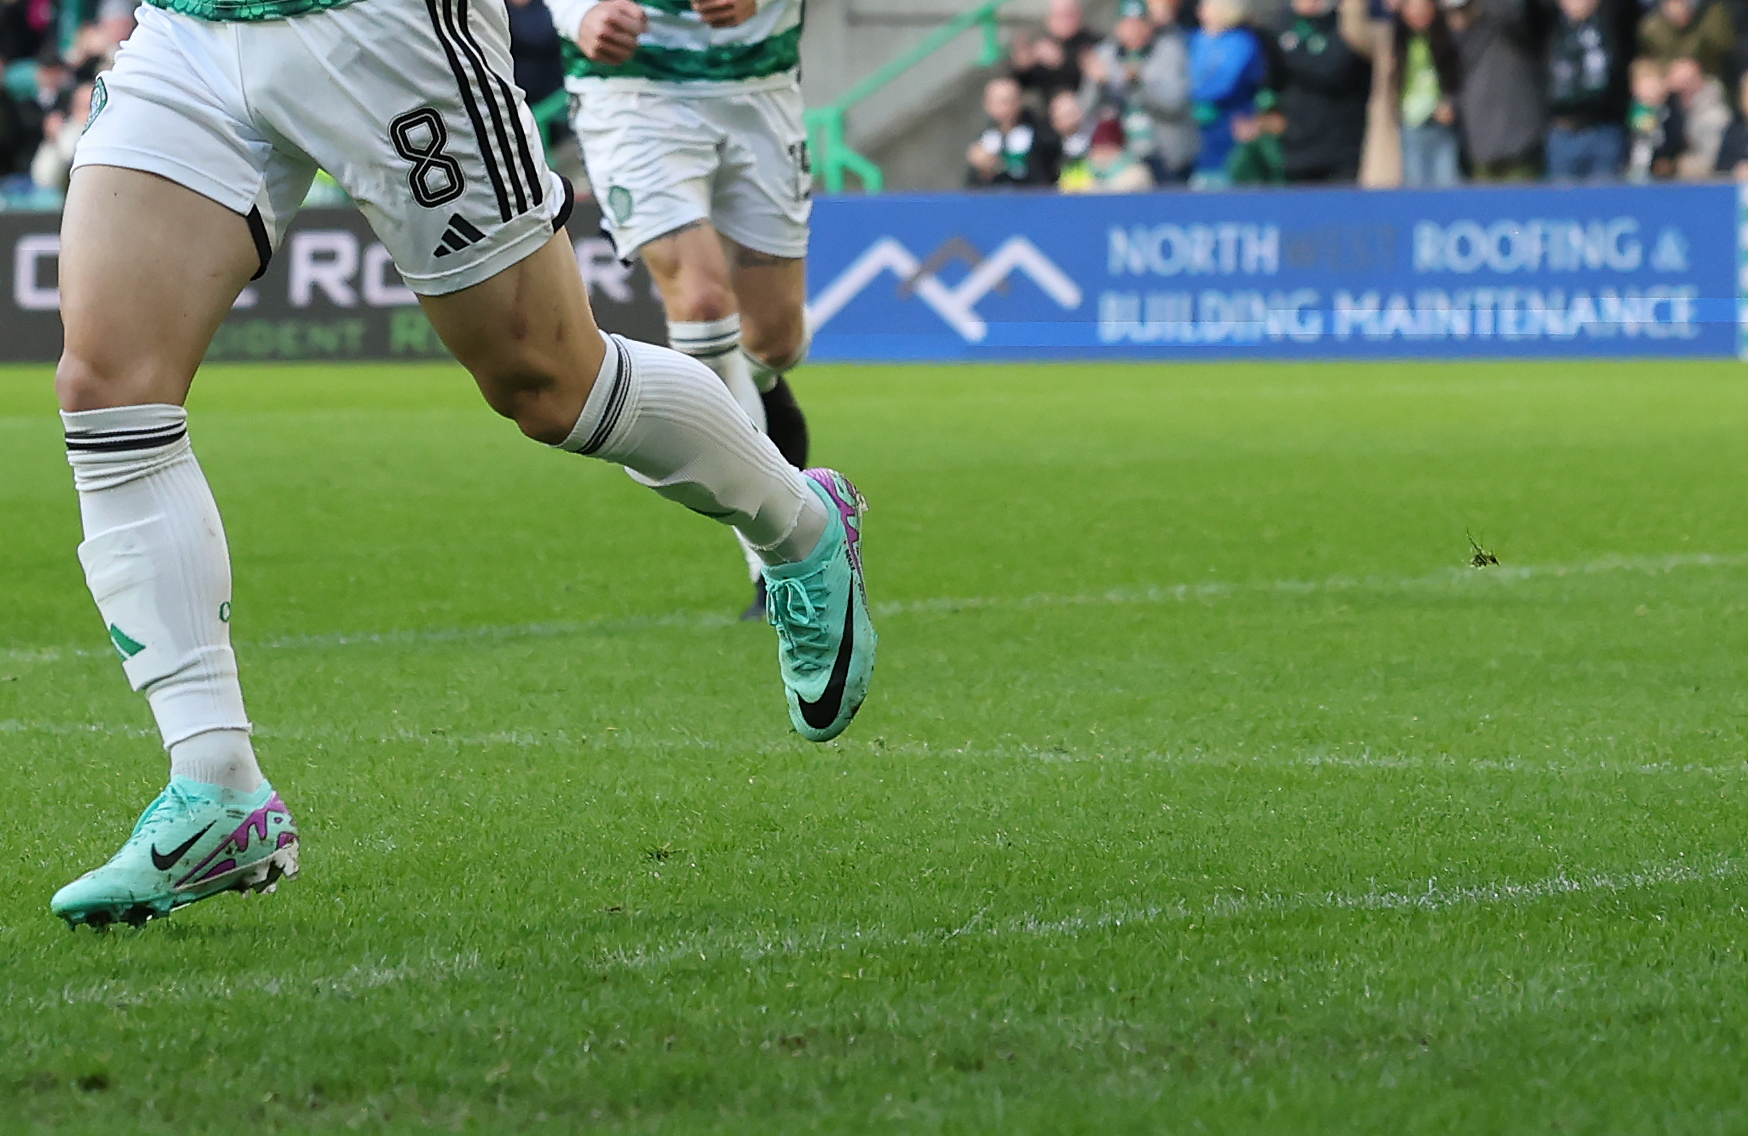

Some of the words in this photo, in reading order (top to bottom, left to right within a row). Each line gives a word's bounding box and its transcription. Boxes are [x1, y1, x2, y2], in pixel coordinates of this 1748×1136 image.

[389, 107, 465, 209] 8
[1411, 218, 1643, 273] ROOFING
[1097, 289, 1323, 343] BUILDING
[1332, 284, 1700, 341] MAINTENANCE
